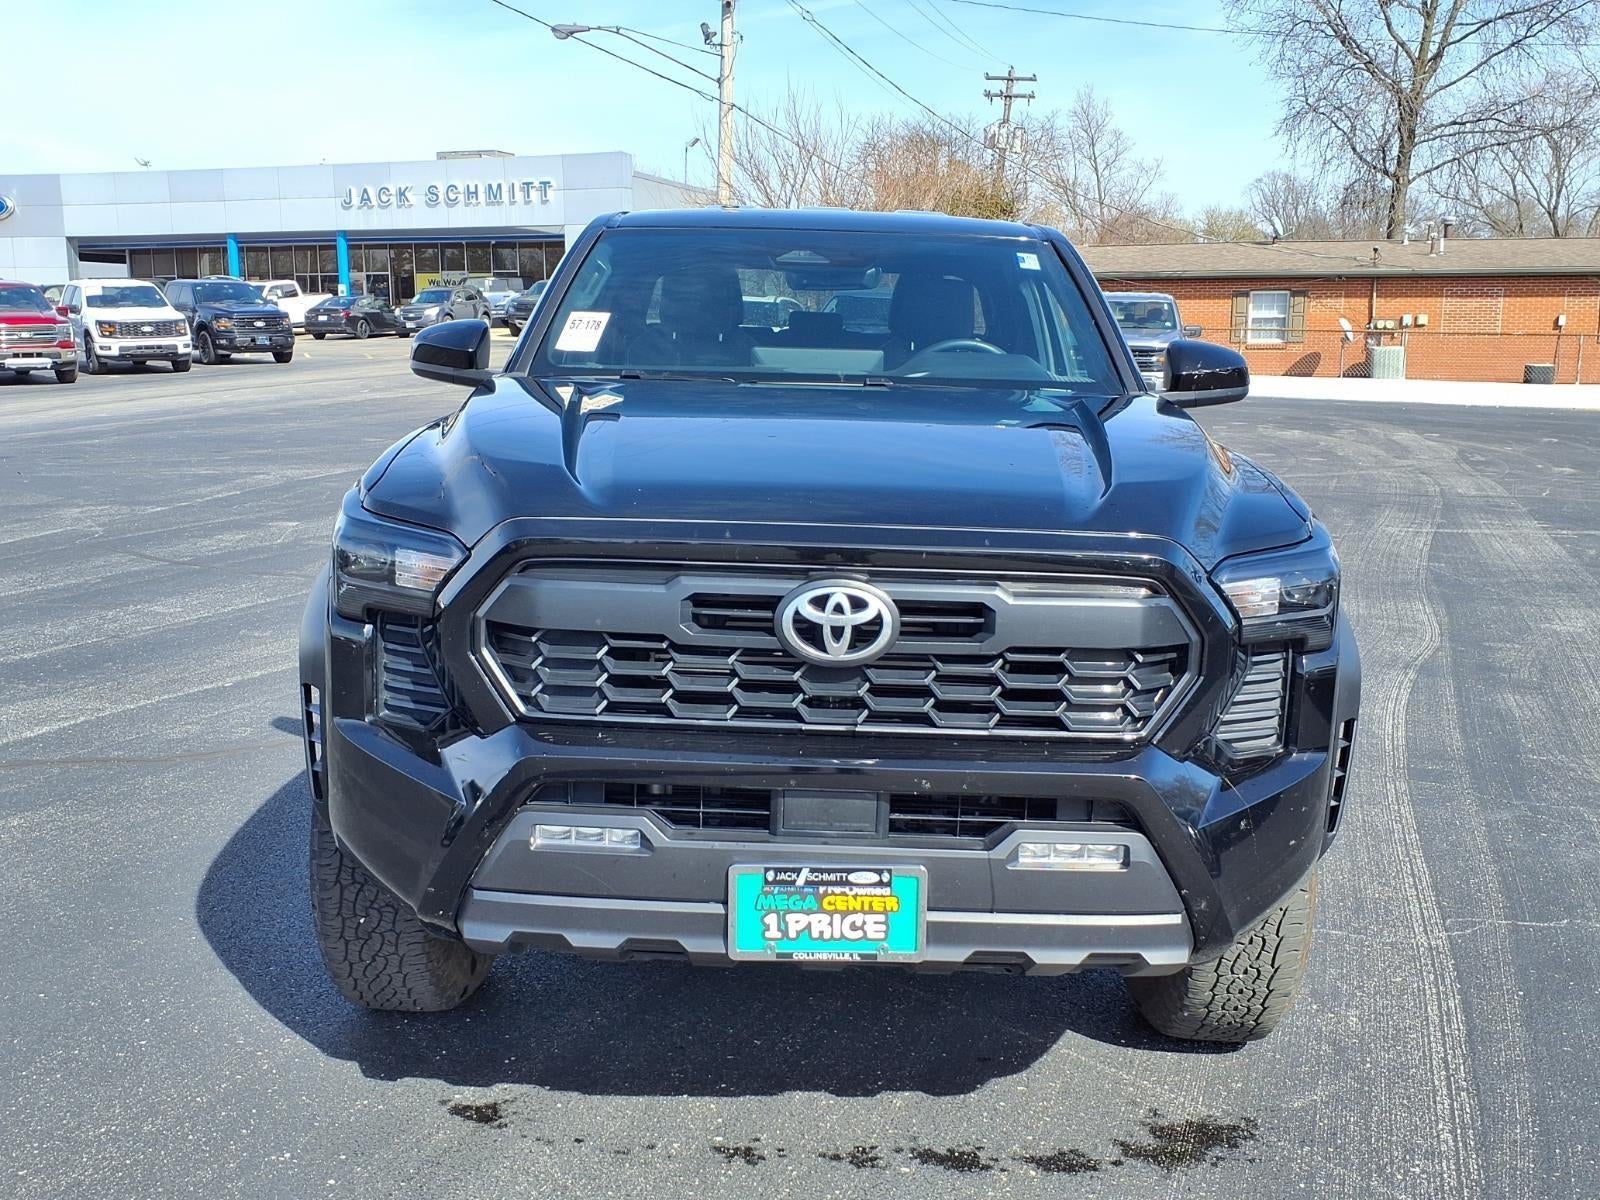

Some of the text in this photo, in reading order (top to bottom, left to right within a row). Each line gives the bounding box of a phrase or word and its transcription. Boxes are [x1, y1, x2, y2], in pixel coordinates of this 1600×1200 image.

[342, 181, 552, 206] JACK SCHMITT
[427, 278, 441, 287] We
[775, 872, 798, 881] JACK
[806, 872, 848, 881] SCHMITT
[756, 894, 899, 912] MEGA CENTER
[763, 912, 888, 940] 1 PRICE
[853, 952, 861, 960] IL
